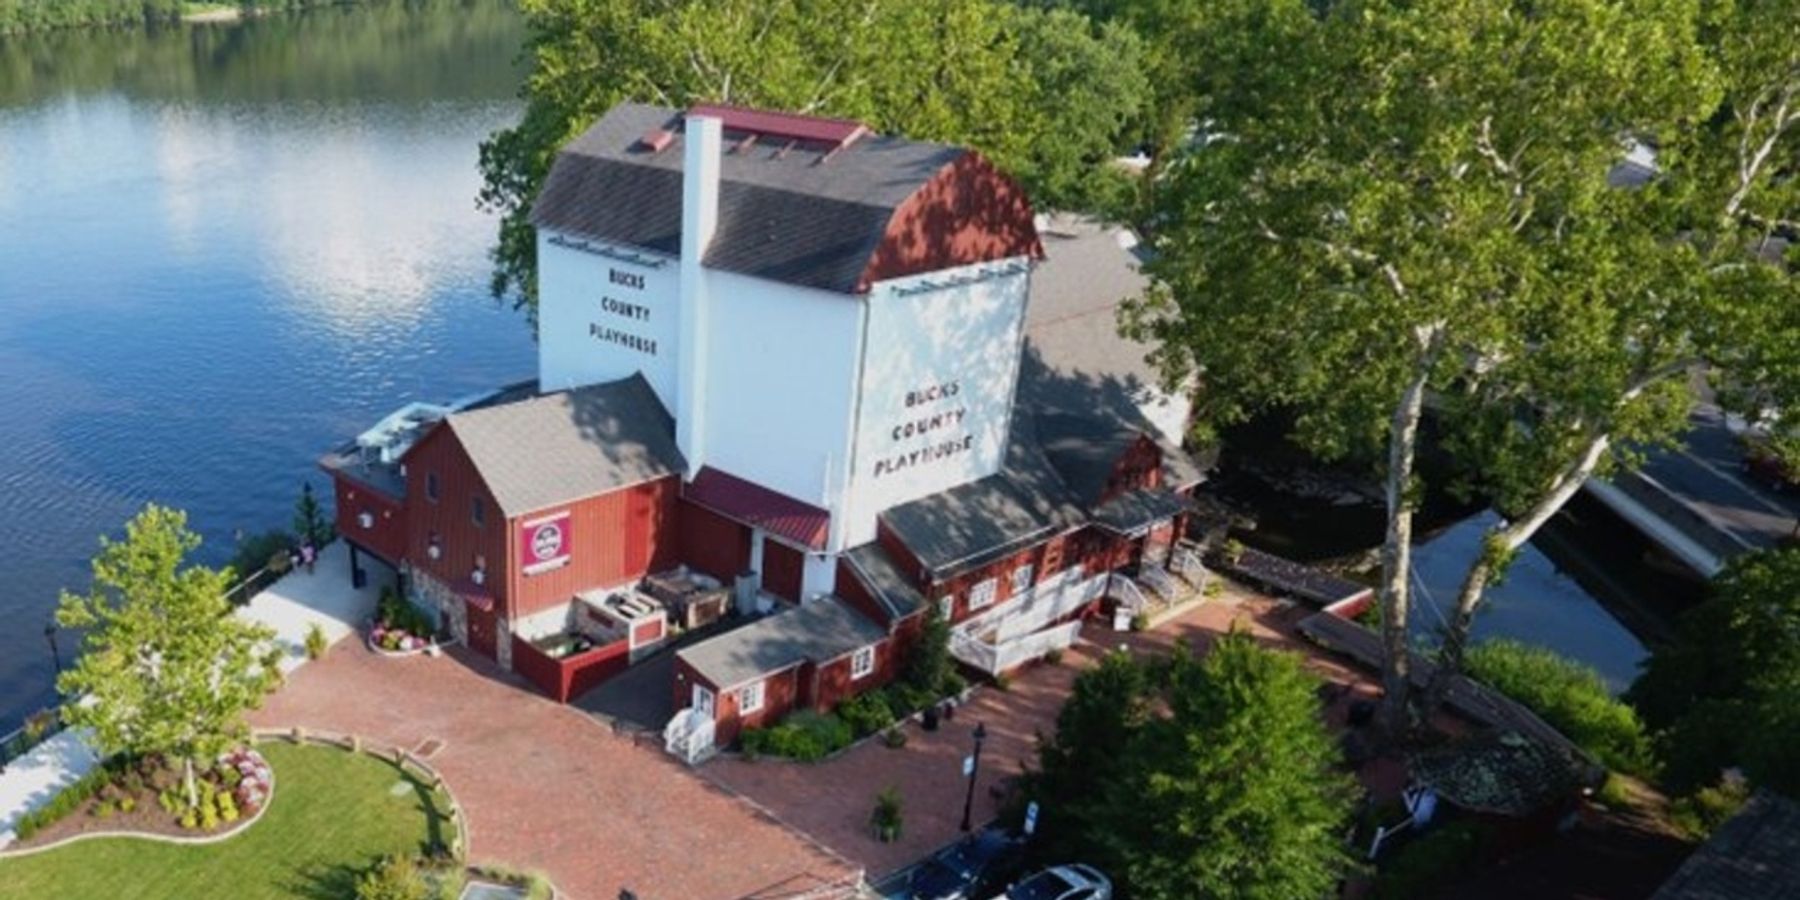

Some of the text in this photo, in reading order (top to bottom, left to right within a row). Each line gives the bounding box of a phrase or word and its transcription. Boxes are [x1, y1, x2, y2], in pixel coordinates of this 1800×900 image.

[609, 268, 645, 290] BUCKS
[601, 296, 650, 321] COUNTY
[589, 322, 657, 356] PLAYHOUSE
[905, 382, 958, 407] BUCKS
[892, 407, 966, 440] COUNTY
[874, 435, 973, 477] PLAYHOUSE
